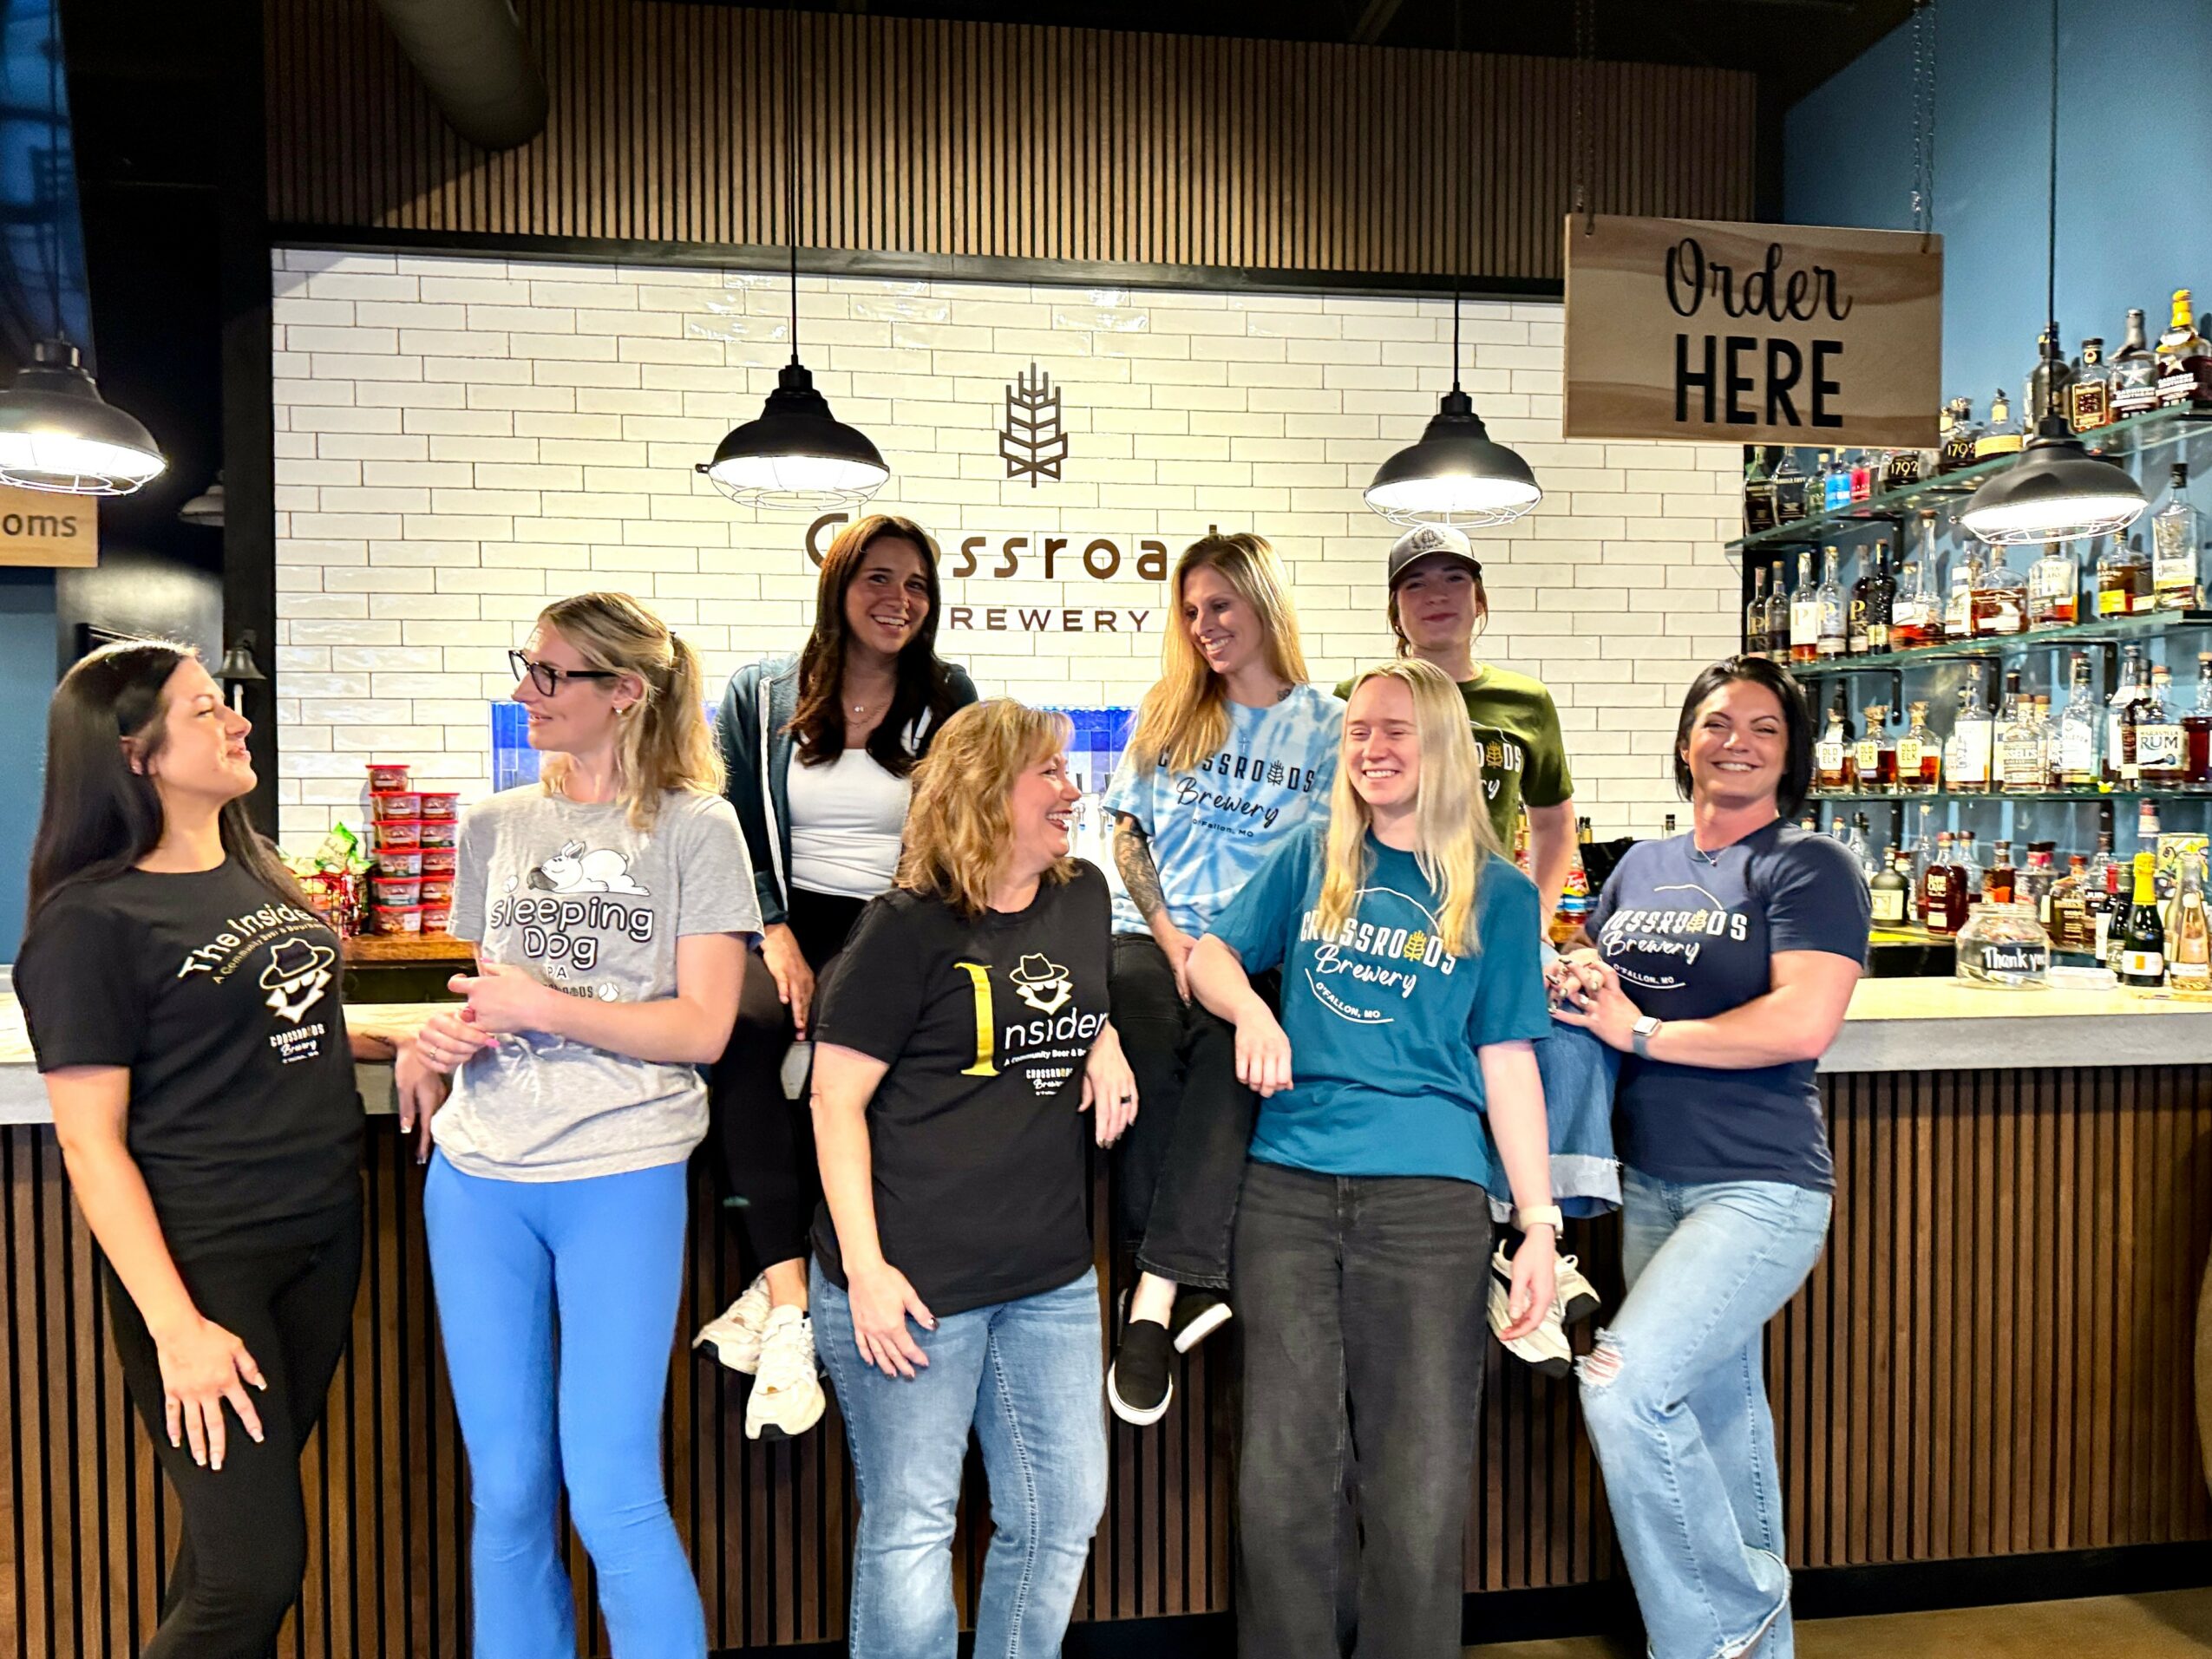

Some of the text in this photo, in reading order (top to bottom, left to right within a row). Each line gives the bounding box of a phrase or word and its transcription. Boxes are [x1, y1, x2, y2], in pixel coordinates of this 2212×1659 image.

[1666, 238, 1853, 322] Order
[1675, 334, 1843, 428] HERE
[1947, 442, 1976, 459] 1792
[1891, 460, 1919, 476] 1792
[2, 513, 77, 538] oms
[805, 513, 1218, 580] Cssroa
[951, 607, 1150, 632] REWERY
[1794, 608, 1810, 626] P
[1860, 746, 1874, 754] OLD
[1901, 743, 1918, 753] OLD
[2140, 736, 2178, 750] RUM
[1901, 753, 1918, 761] ELK
[1176, 776, 1279, 829] Brewery
[1238, 828, 1255, 838] MO
[177, 903, 320, 978] The Inside
[523, 925, 599, 971] Dog
[1602, 930, 1700, 965] Brewery
[1980, 946, 2028, 970] Thank
[546, 964, 570, 980] PA
[1314, 944, 1417, 998] Brewery
[1316, 982, 1381, 1019] O'FALLON, MO
